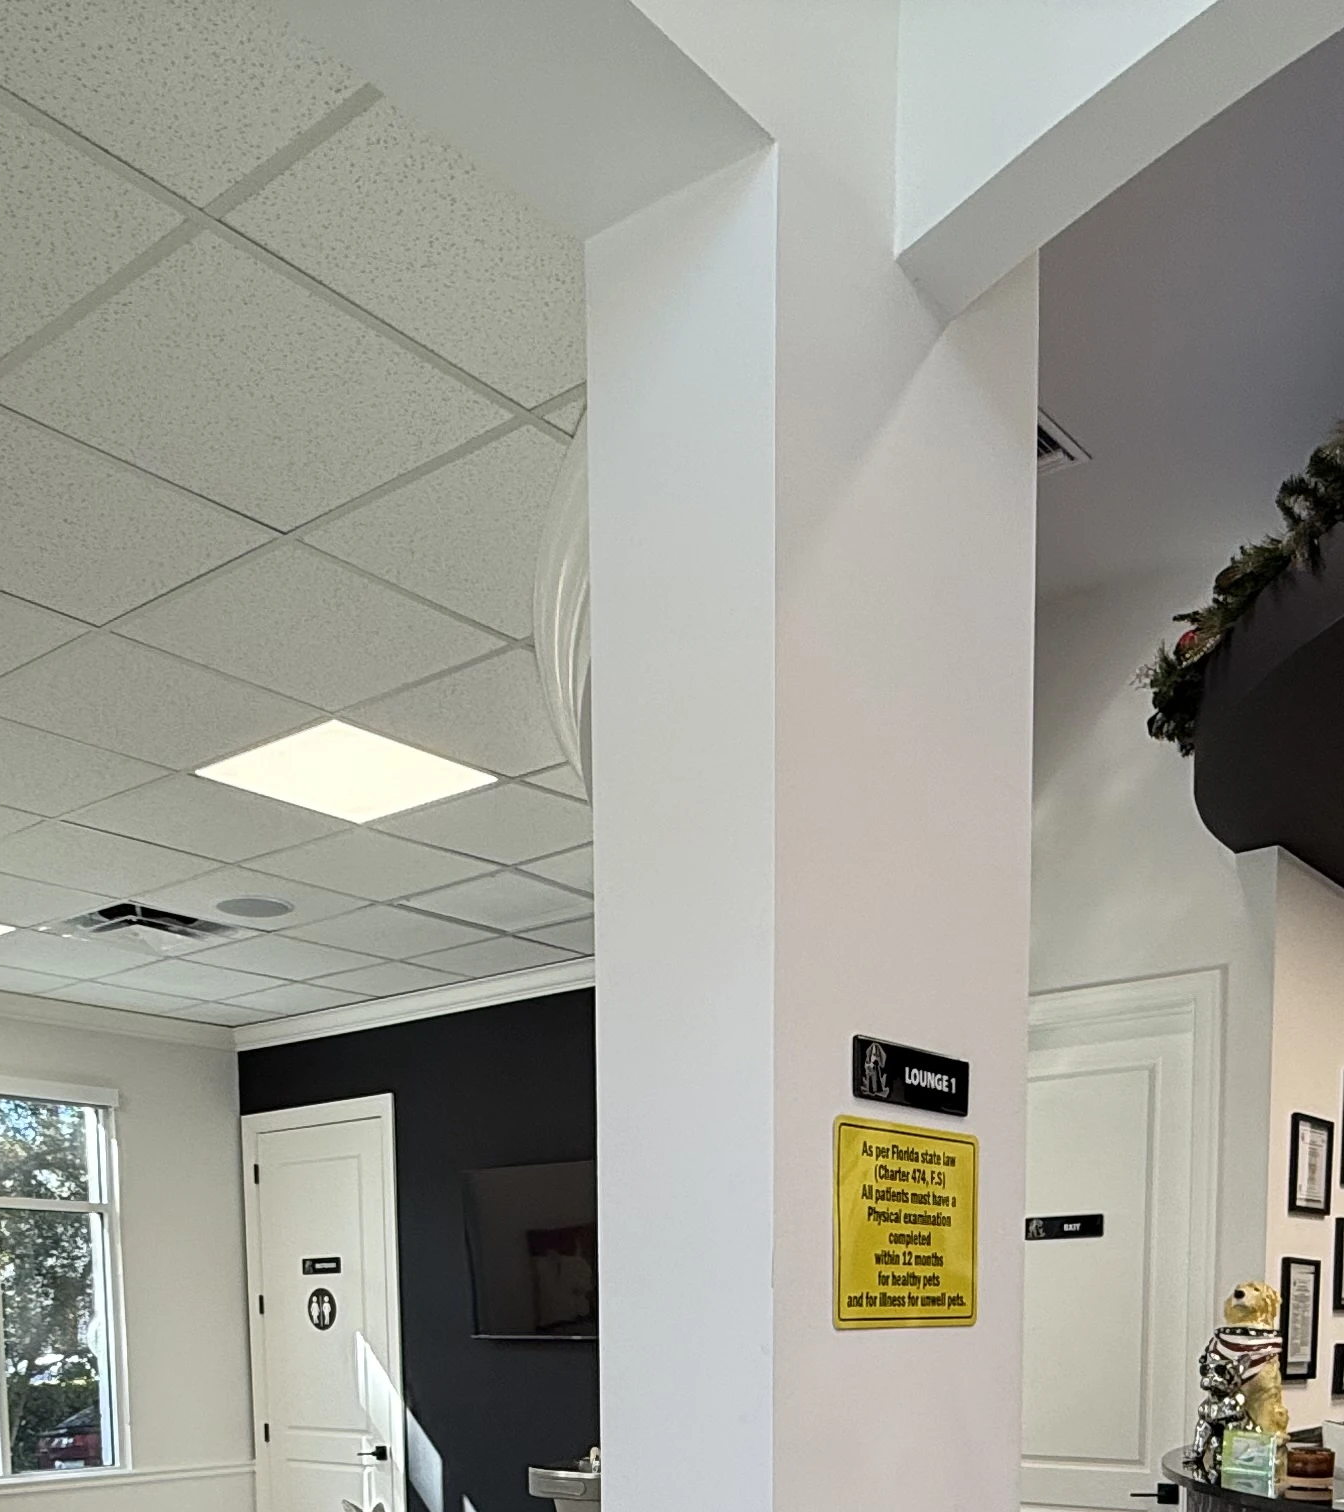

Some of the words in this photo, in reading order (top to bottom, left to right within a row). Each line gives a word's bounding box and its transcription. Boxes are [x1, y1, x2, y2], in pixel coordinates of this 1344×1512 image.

[905, 1066, 949, 1093] LOUNGE
[950, 1077, 957, 1094] 1
[862, 1141, 874, 1157] As
[875, 1146, 890, 1160] per
[891, 1144, 920, 1164] Florida
[920, 1150, 942, 1165] state
[942, 1151, 957, 1168] law
[911, 1168, 929, 1188] 474,
[861, 1184, 874, 1200] All
[875, 1187, 909, 1205] patients
[910, 1190, 931, 1206] must
[932, 1191, 950, 1207] have
[951, 1196, 957, 1208] a
[867, 1206, 902, 1226] Physical
[903, 1210, 952, 1227] examination
[888, 1230, 932, 1248] completed
[874, 1250, 900, 1265] within
[902, 1251, 913, 1266] 12
[914, 1252, 944, 1267] months
[877, 1270, 890, 1287] for
[891, 1271, 922, 1290] healthy
[922, 1272, 940, 1290] pets
[847, 1292, 864, 1308] and
[865, 1292, 878, 1308] for
[878, 1292, 906, 1308] illness
[907, 1291, 919, 1308] for
[920, 1292, 947, 1307] unwell
[947, 1293, 966, 1310] pets.
